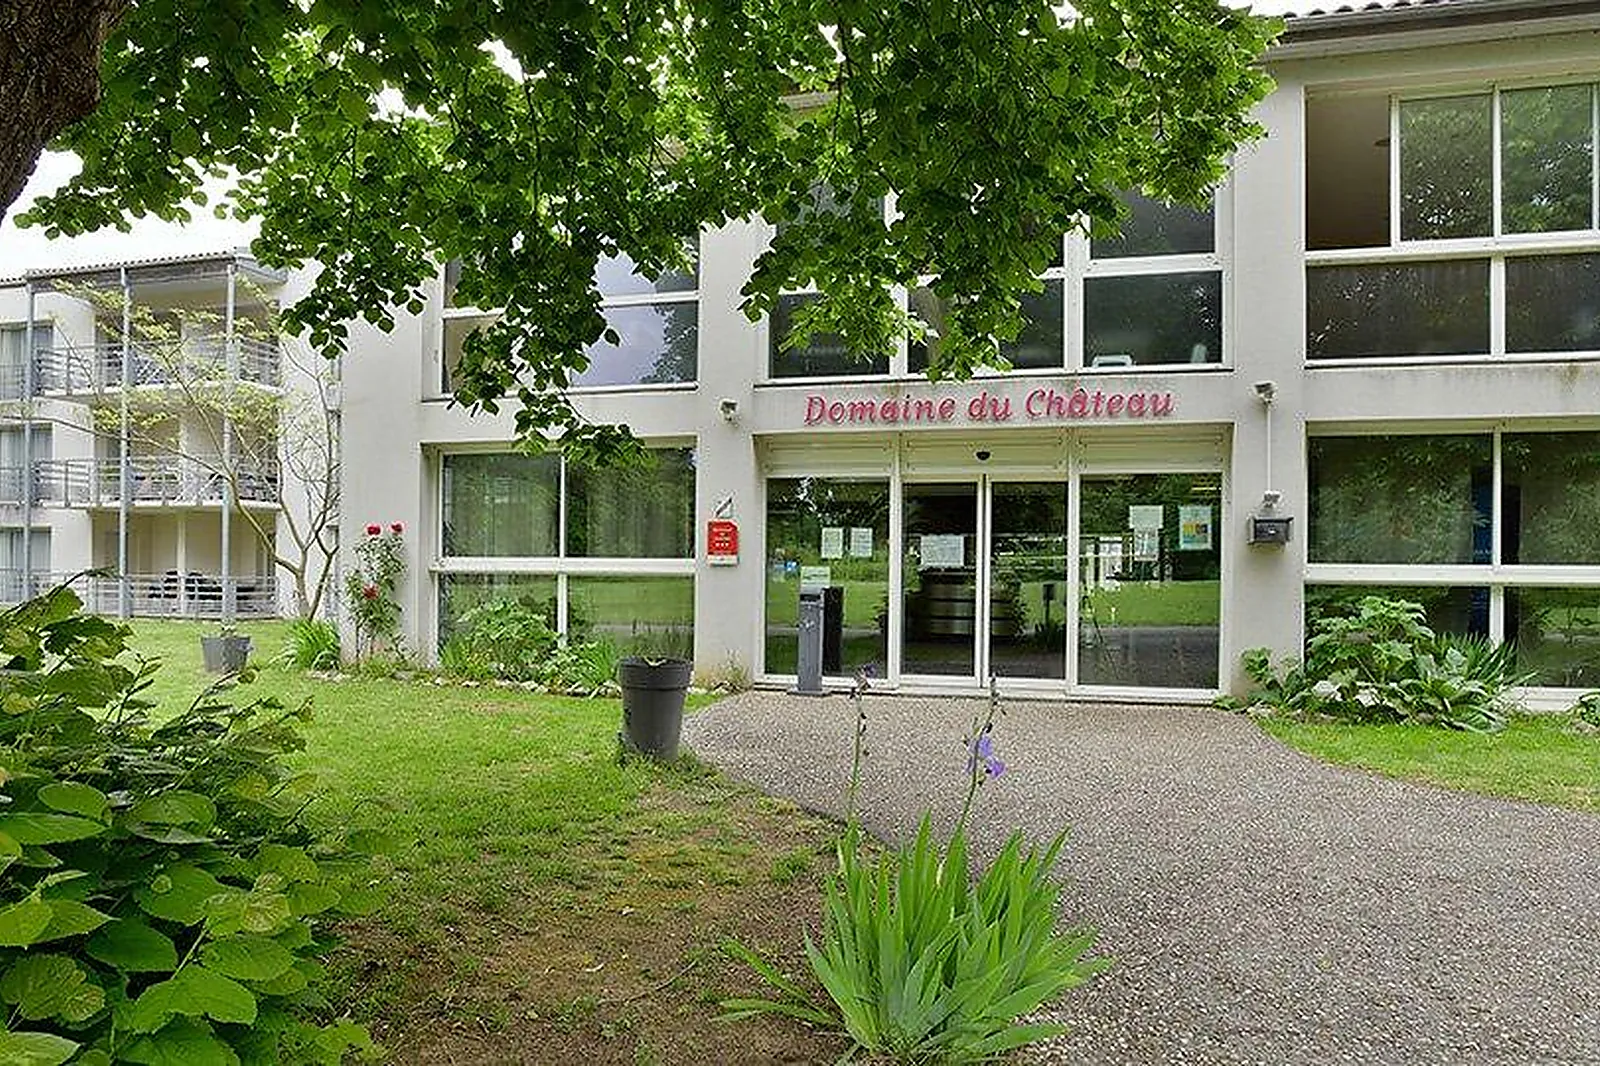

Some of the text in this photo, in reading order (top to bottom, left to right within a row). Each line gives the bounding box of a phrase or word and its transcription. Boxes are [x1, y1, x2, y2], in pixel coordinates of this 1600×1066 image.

[804, 387, 1175, 425] Domaine du Château
